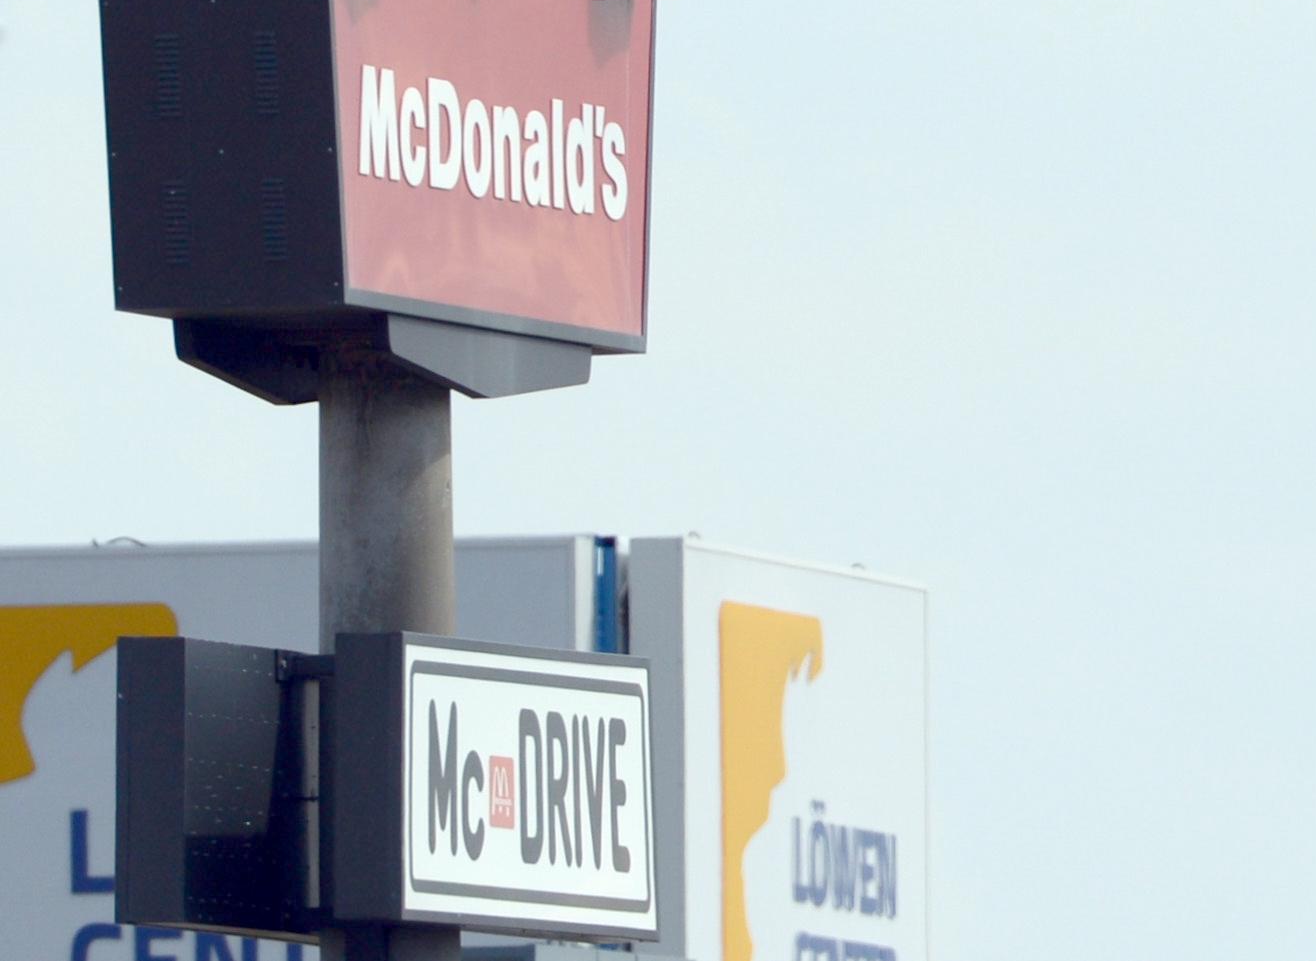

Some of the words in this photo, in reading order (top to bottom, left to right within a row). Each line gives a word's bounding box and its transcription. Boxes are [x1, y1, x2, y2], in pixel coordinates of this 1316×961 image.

[359, 64, 628, 221] McDonald's
[518, 708, 631, 872] DRIVE
[793, 798, 897, 920] LÖWEN
